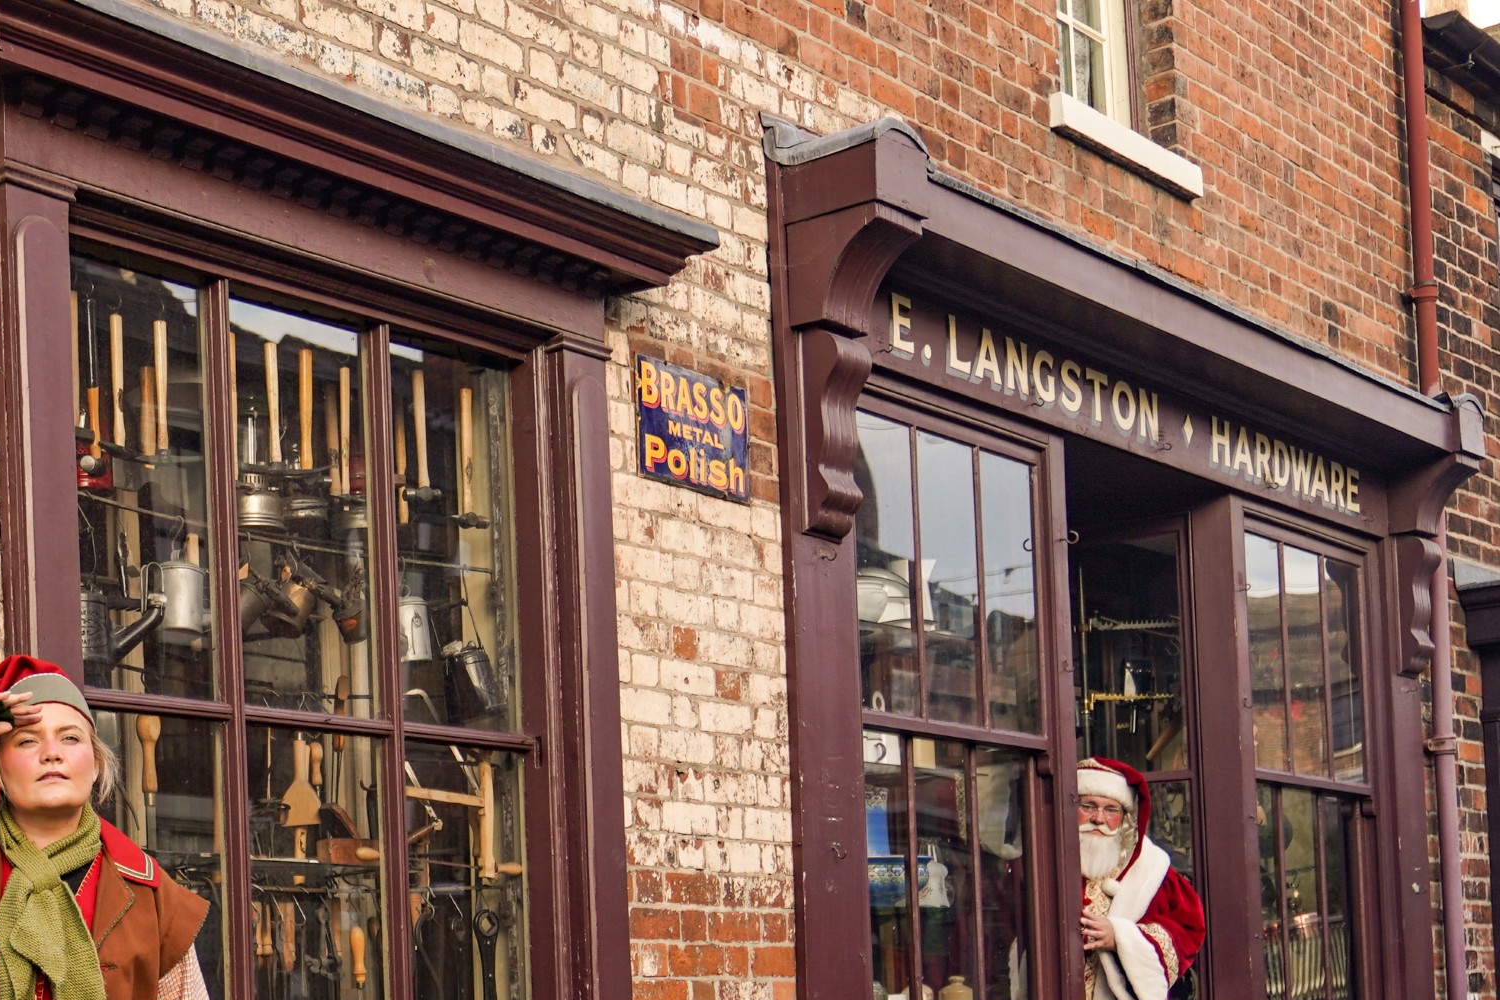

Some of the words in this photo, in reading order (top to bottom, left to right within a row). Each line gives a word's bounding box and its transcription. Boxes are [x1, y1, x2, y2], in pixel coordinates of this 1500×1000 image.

[640, 360, 745, 434] BRASSO
[889, 292, 933, 366] E.
[945, 313, 1160, 443] LANGSTON
[1209, 415, 1361, 516] HARDWARE
[644, 433, 746, 497] Polish
[667, 420, 724, 450] METAL
